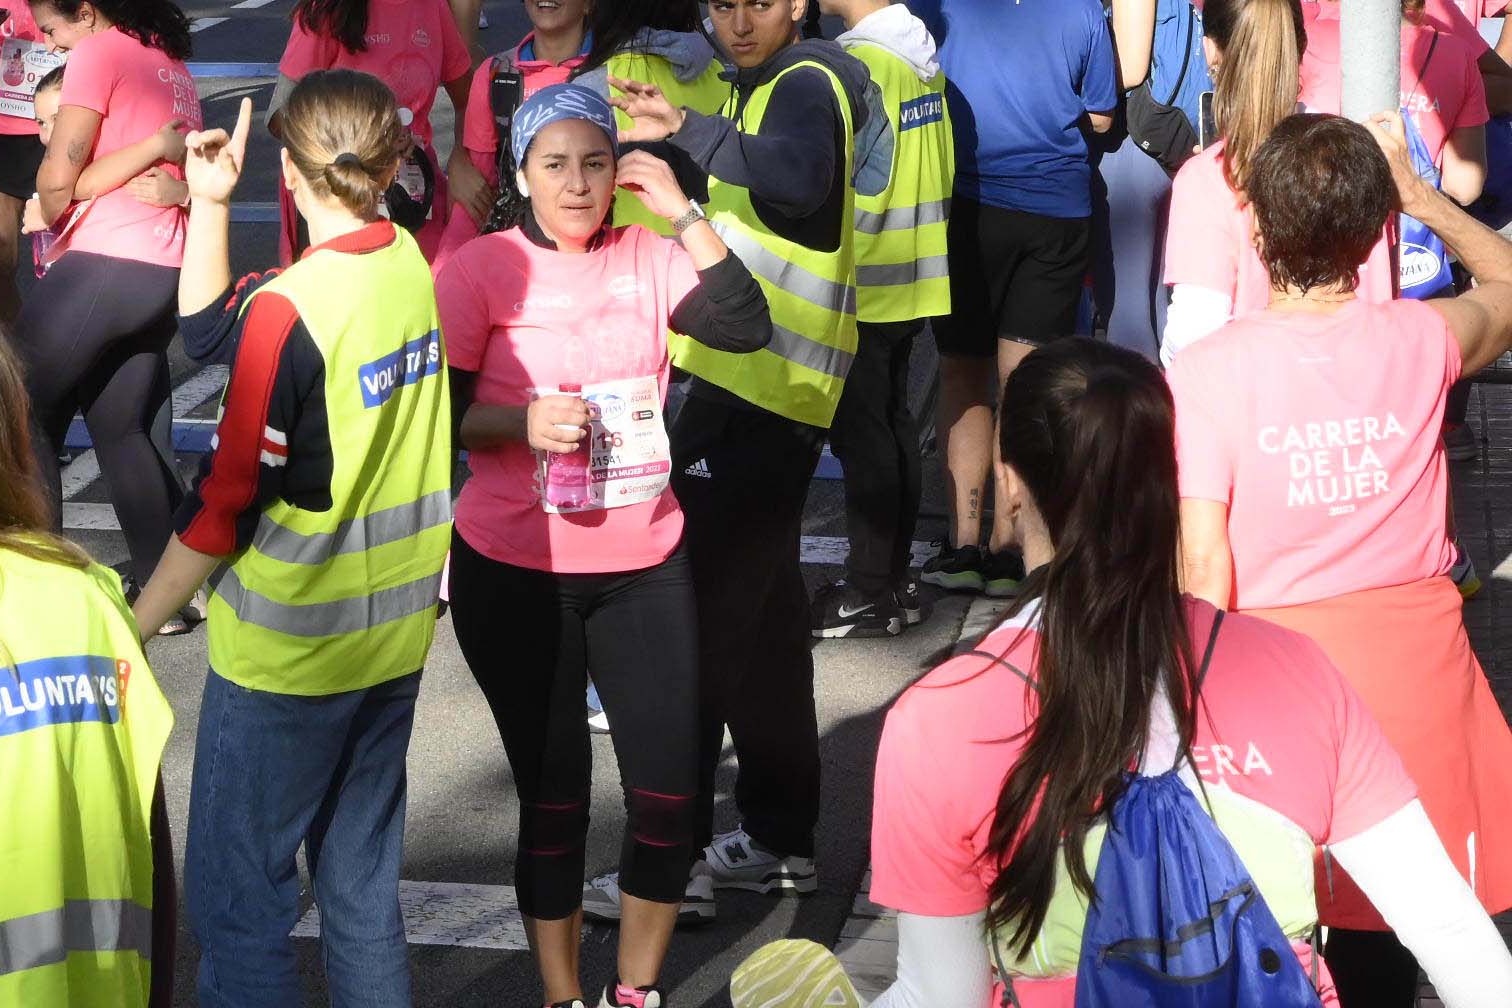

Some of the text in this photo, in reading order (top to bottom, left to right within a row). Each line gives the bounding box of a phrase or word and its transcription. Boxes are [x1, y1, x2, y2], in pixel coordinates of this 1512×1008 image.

[0, 102, 26, 111] OYSHO
[362, 341, 439, 395] VOLNTAS
[630, 394, 652, 403] SUMA
[592, 432, 624, 449] 16
[1258, 413, 1405, 456] CARRERA
[1291, 446, 1382, 479] DE LA
[608, 469, 617, 479] LA
[619, 467, 644, 477] MUJER
[685, 467, 712, 479] adidas
[627, 481, 664, 495] Santander
[1288, 469, 1390, 508] MUJER
